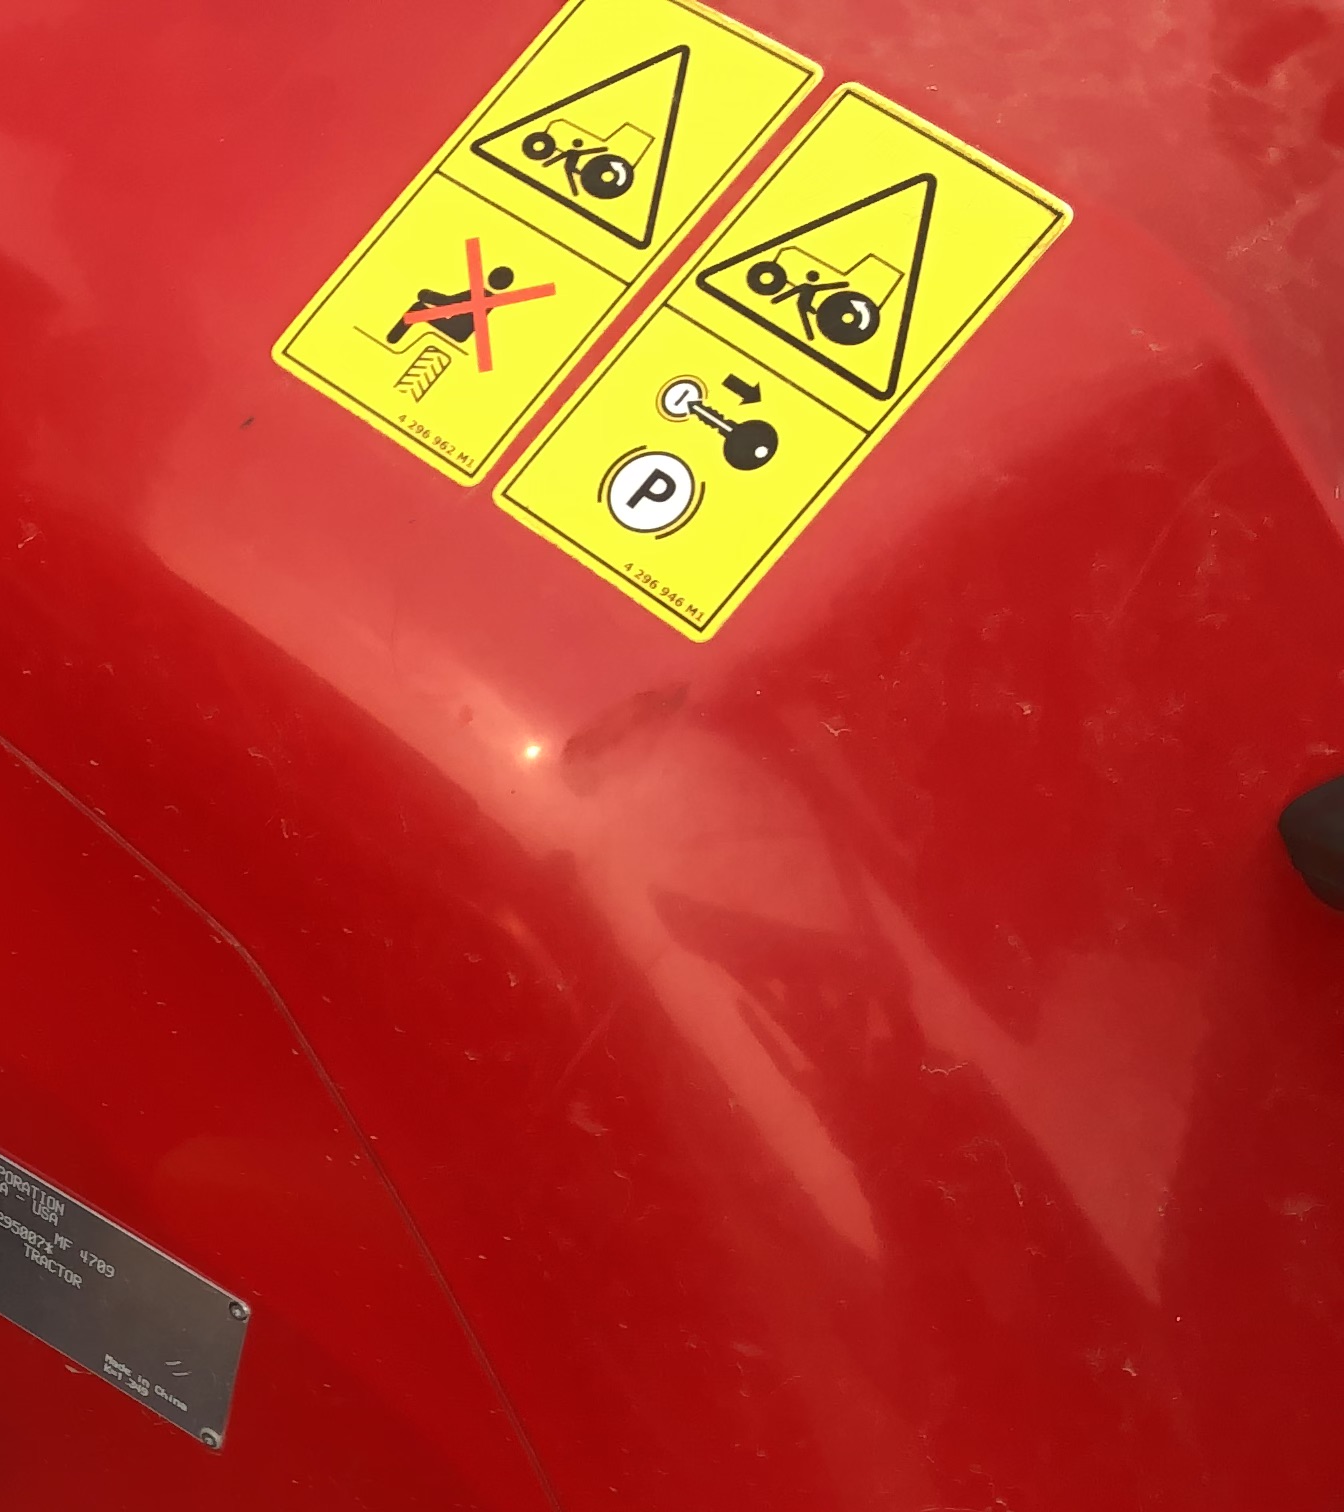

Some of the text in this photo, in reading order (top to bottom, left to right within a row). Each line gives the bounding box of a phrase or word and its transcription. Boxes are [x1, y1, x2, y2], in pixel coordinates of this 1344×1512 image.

[407, 419, 431, 439] 296
[432, 435, 456, 456] 962
[456, 451, 475, 468] M1
[625, 467, 677, 509] P
[633, 568, 660, 590] 296
[659, 586, 686, 607] 946
[685, 603, 705, 622] M1
[32, 1200, 59, 1227] USA
[23, 1242, 83, 1289] TRACTOR
[53, 1232, 116, 1278] MF 4709
[137, 1374, 151, 1389] in
[154, 1384, 188, 1412] China
